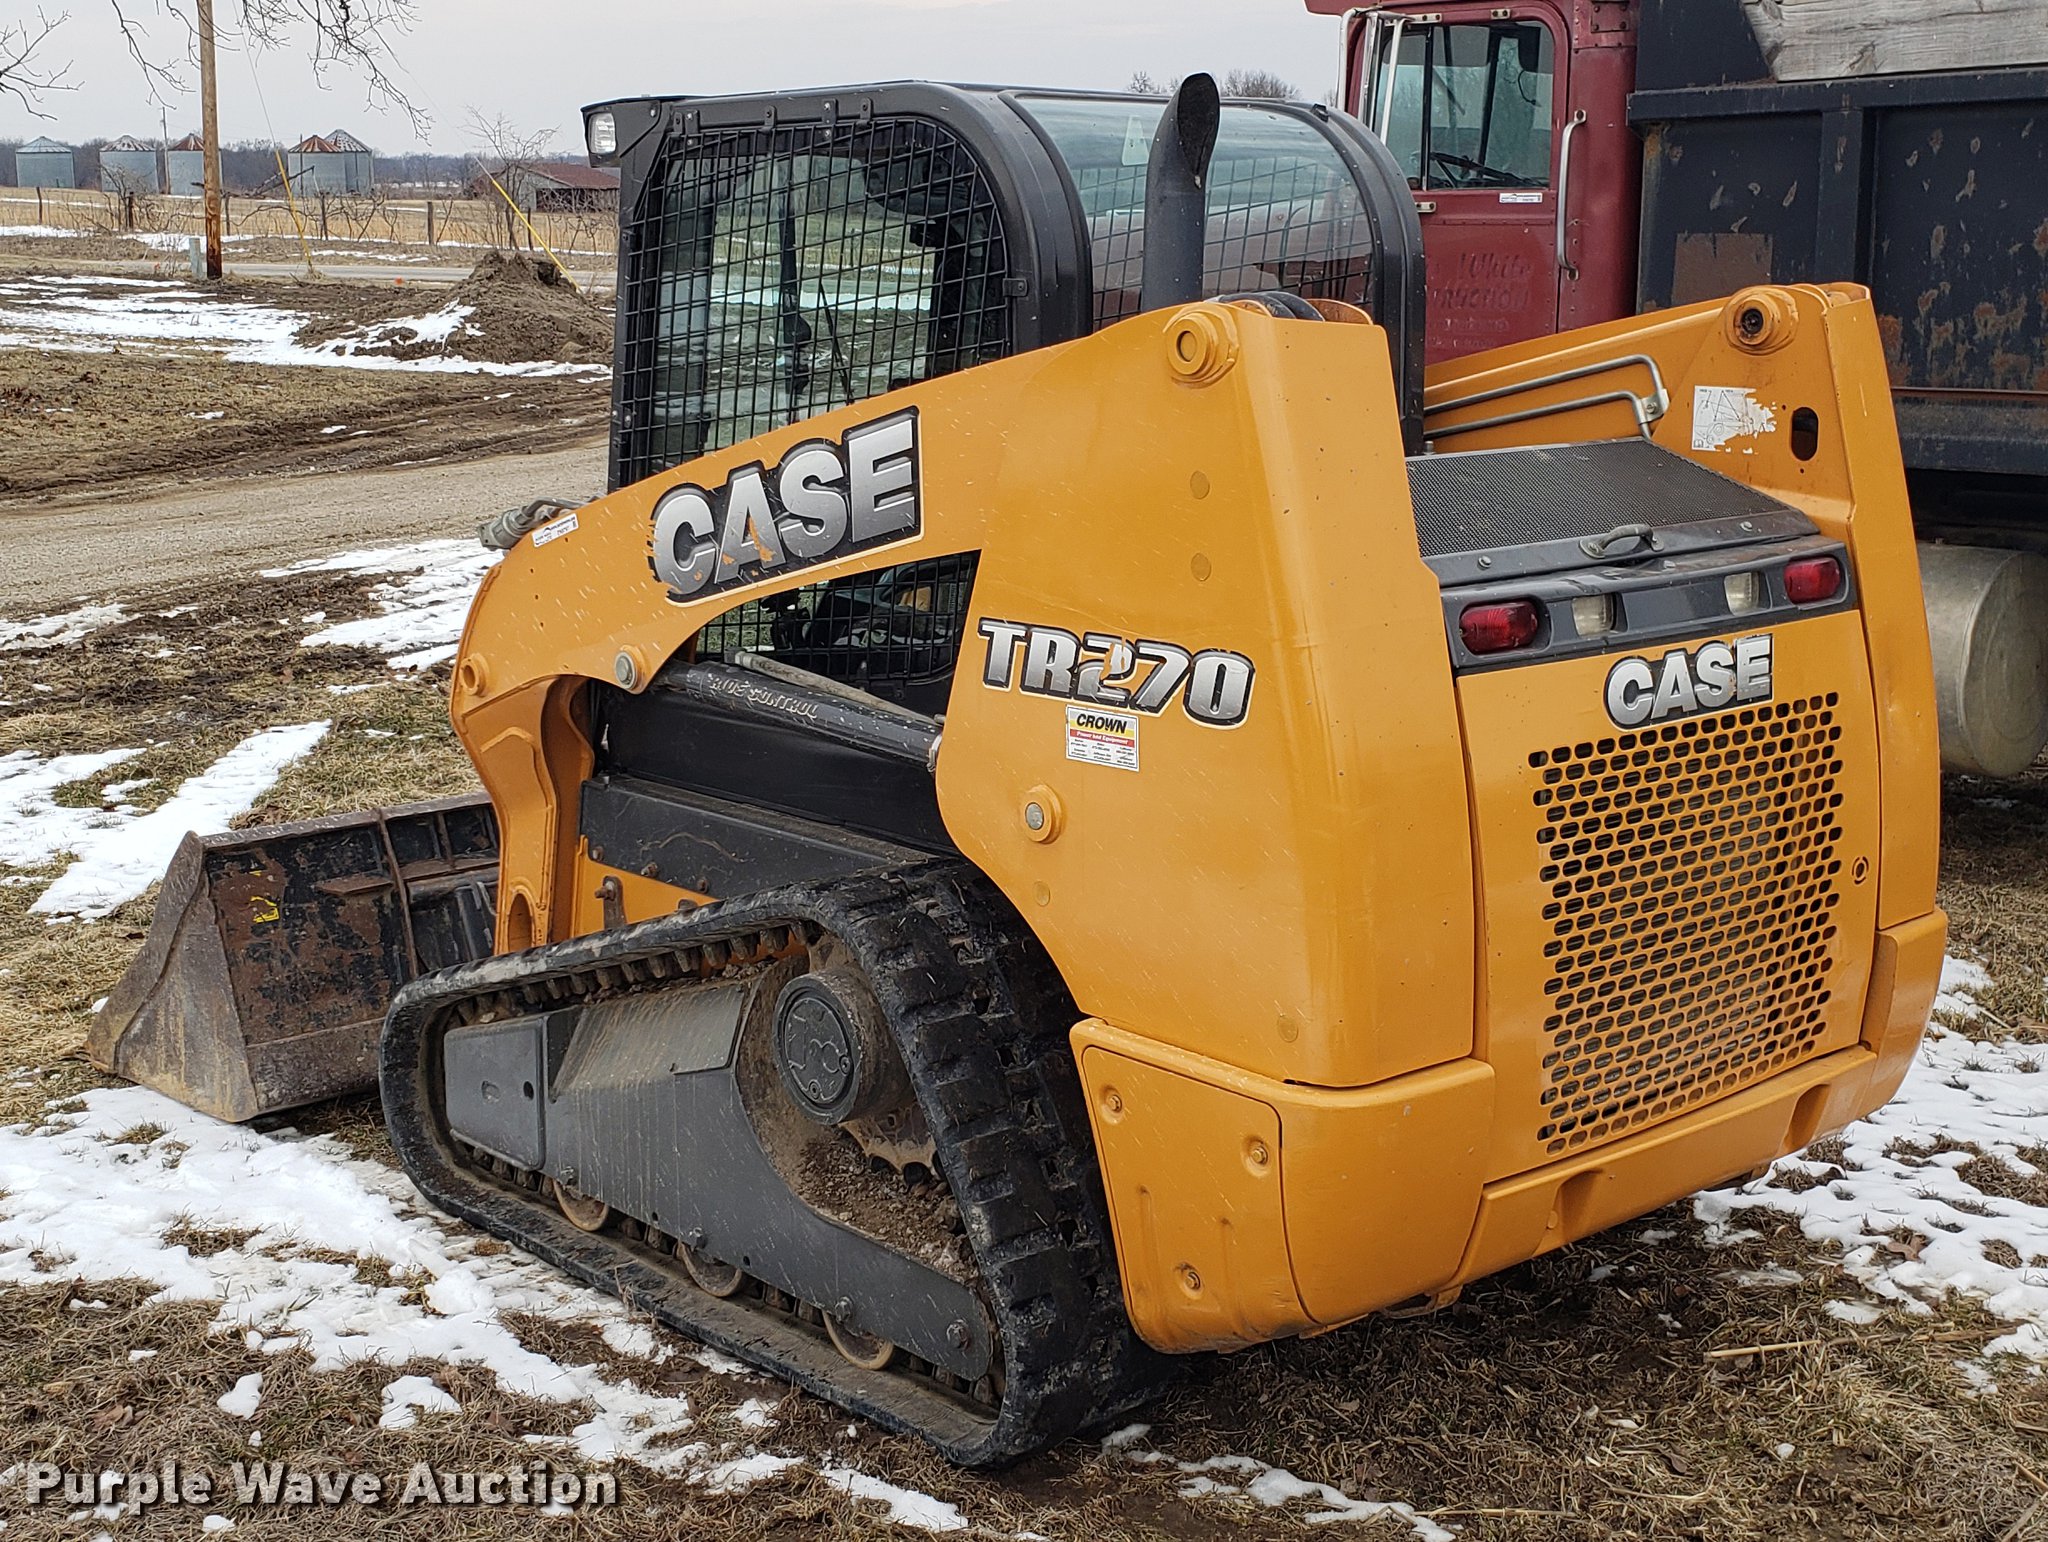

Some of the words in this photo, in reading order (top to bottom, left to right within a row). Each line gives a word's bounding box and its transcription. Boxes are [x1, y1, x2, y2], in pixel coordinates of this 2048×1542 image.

[650, 407, 921, 601] CASE
[978, 617, 1255, 729] TR270
[1077, 713, 1127, 733] CROWN
[1604, 634, 1773, 730] CASE
